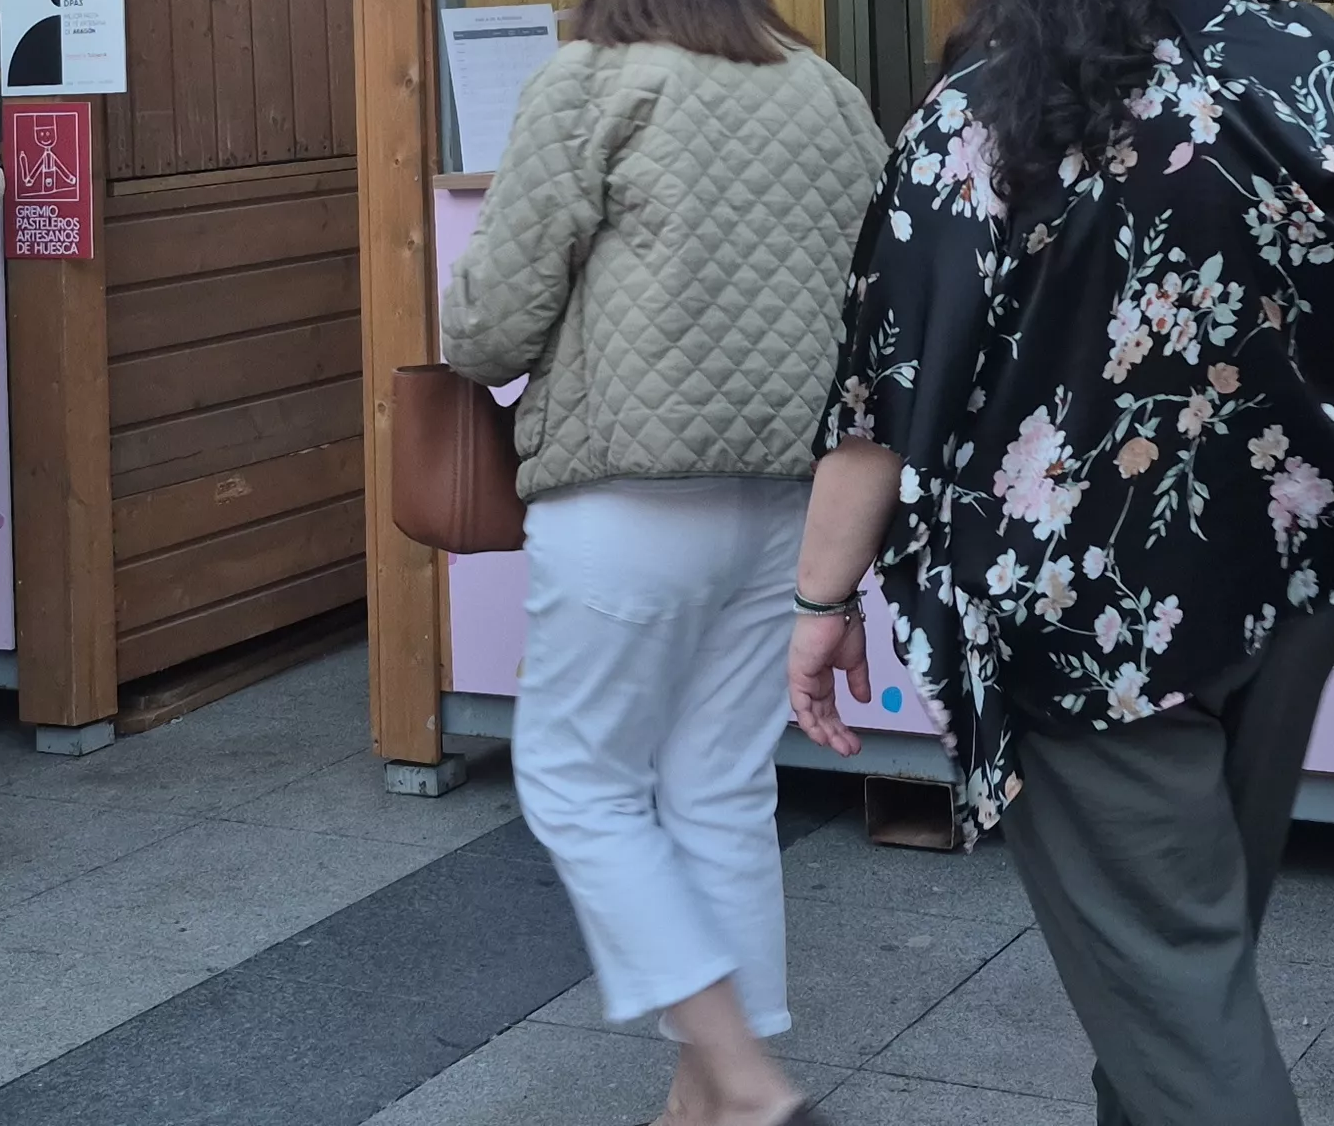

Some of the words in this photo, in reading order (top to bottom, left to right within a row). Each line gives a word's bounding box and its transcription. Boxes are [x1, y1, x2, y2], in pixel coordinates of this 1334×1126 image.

[15, 205, 58, 217] GREMIO
[16, 217, 80, 229] PASTELEROS
[16, 229, 79, 242] ARTESANOS
[16, 242, 30, 254] DE
[34, 242, 79, 254] HUESCA
